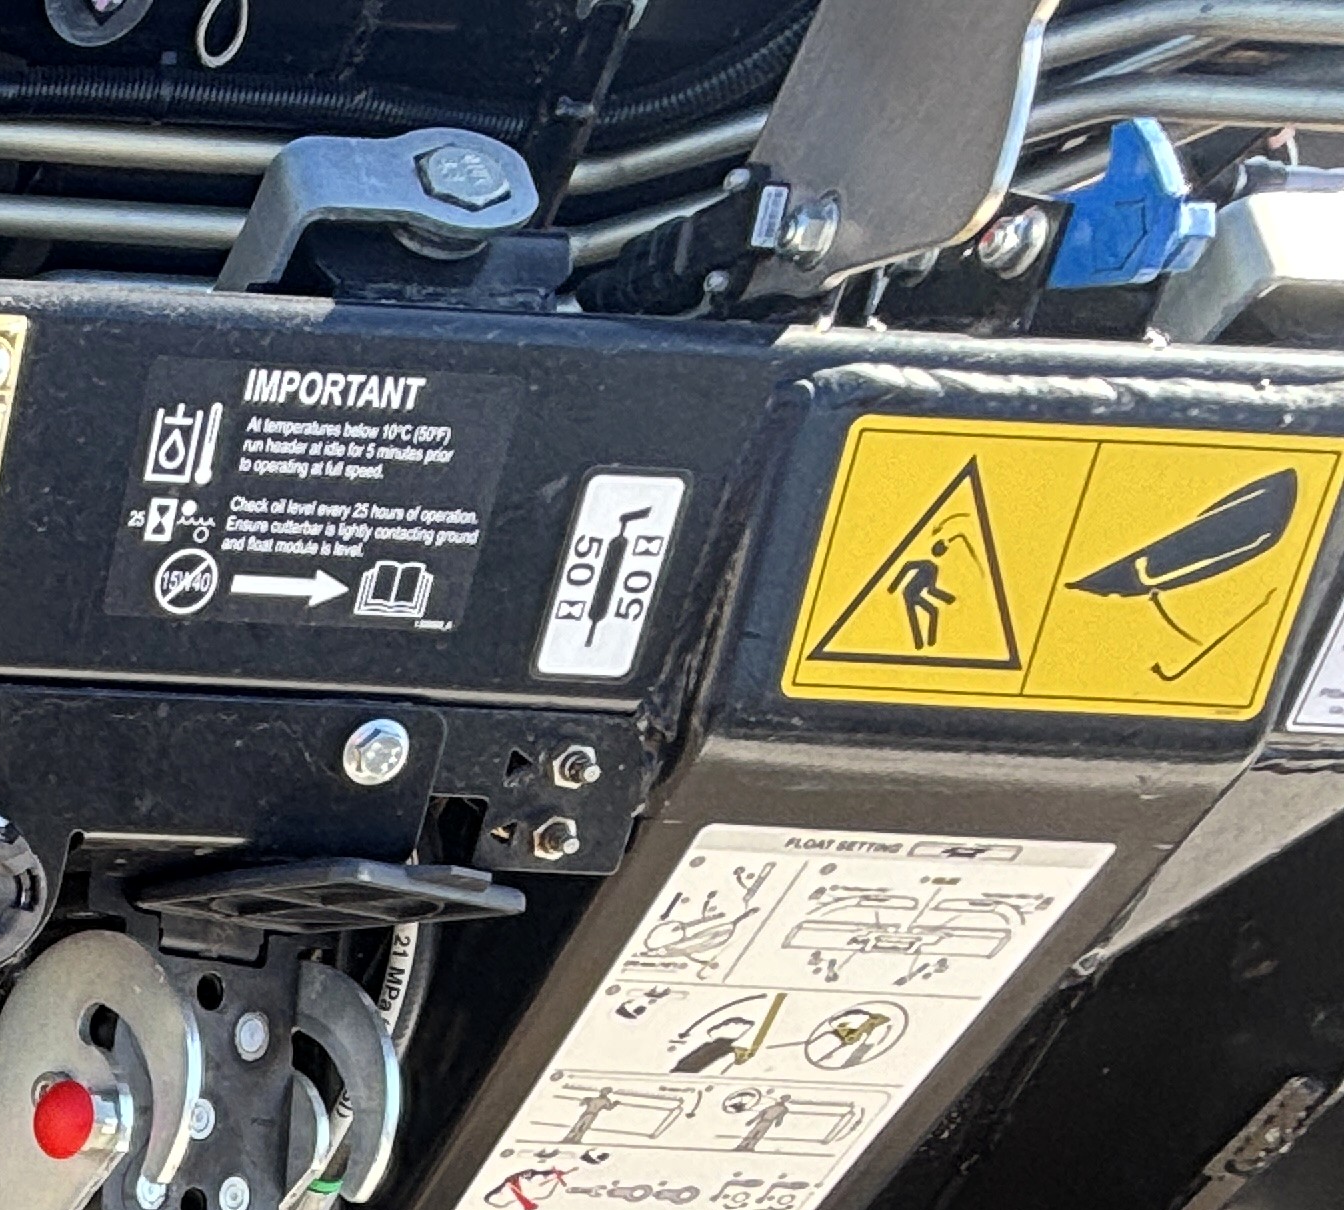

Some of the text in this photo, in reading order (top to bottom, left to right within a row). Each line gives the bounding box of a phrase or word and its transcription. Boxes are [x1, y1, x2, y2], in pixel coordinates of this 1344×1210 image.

[244, 368, 428, 410] IMPORTANT
[246, 416, 263, 434] At
[264, 418, 342, 437] temperatures
[342, 421, 379, 439] below
[382, 423, 413, 441] 10°C
[242, 438, 456, 465] run header at idle for 5 minutes prior
[238, 456, 385, 480] to operating at full speed.
[127, 510, 146, 528] 25
[230, 496, 479, 525] Check oil level every 25 hours of operation.
[225, 515, 480, 546] Ensure cutterbar is lightly contacting ground
[221, 534, 364, 558] and float module is level.
[566, 534, 604, 587] 50
[614, 570, 652, 622] 50
[377, 933, 411, 1012] 21 MPa
